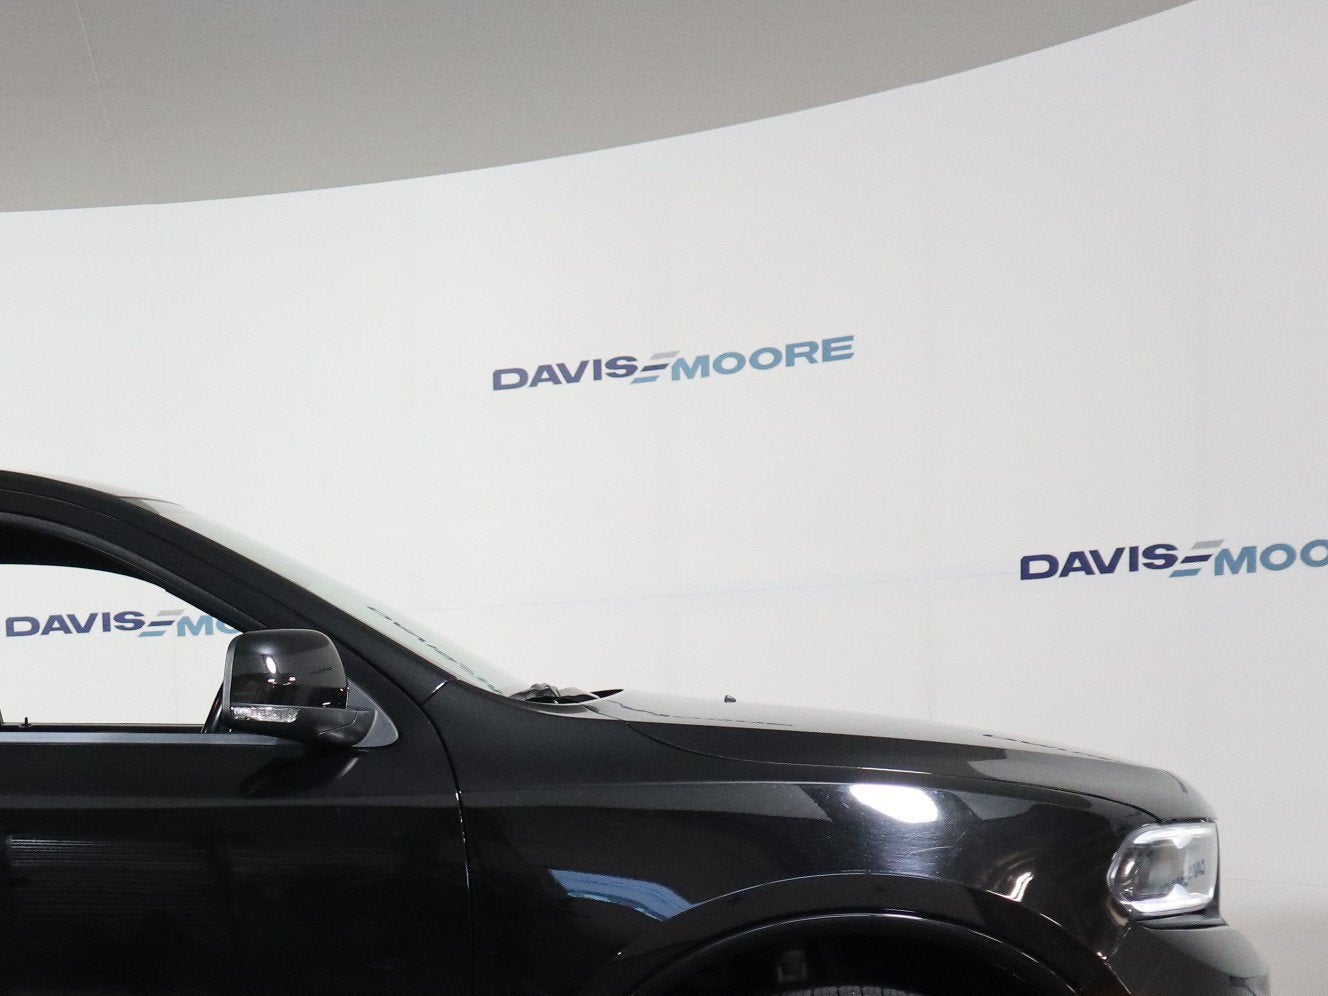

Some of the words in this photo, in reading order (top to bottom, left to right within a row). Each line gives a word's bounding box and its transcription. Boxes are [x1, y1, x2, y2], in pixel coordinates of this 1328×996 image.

[492, 356, 638, 391] DAVIS
[672, 335, 854, 381] MOORE
[1020, 543, 1179, 580] DAVIS
[5, 611, 146, 637] DAVIS
